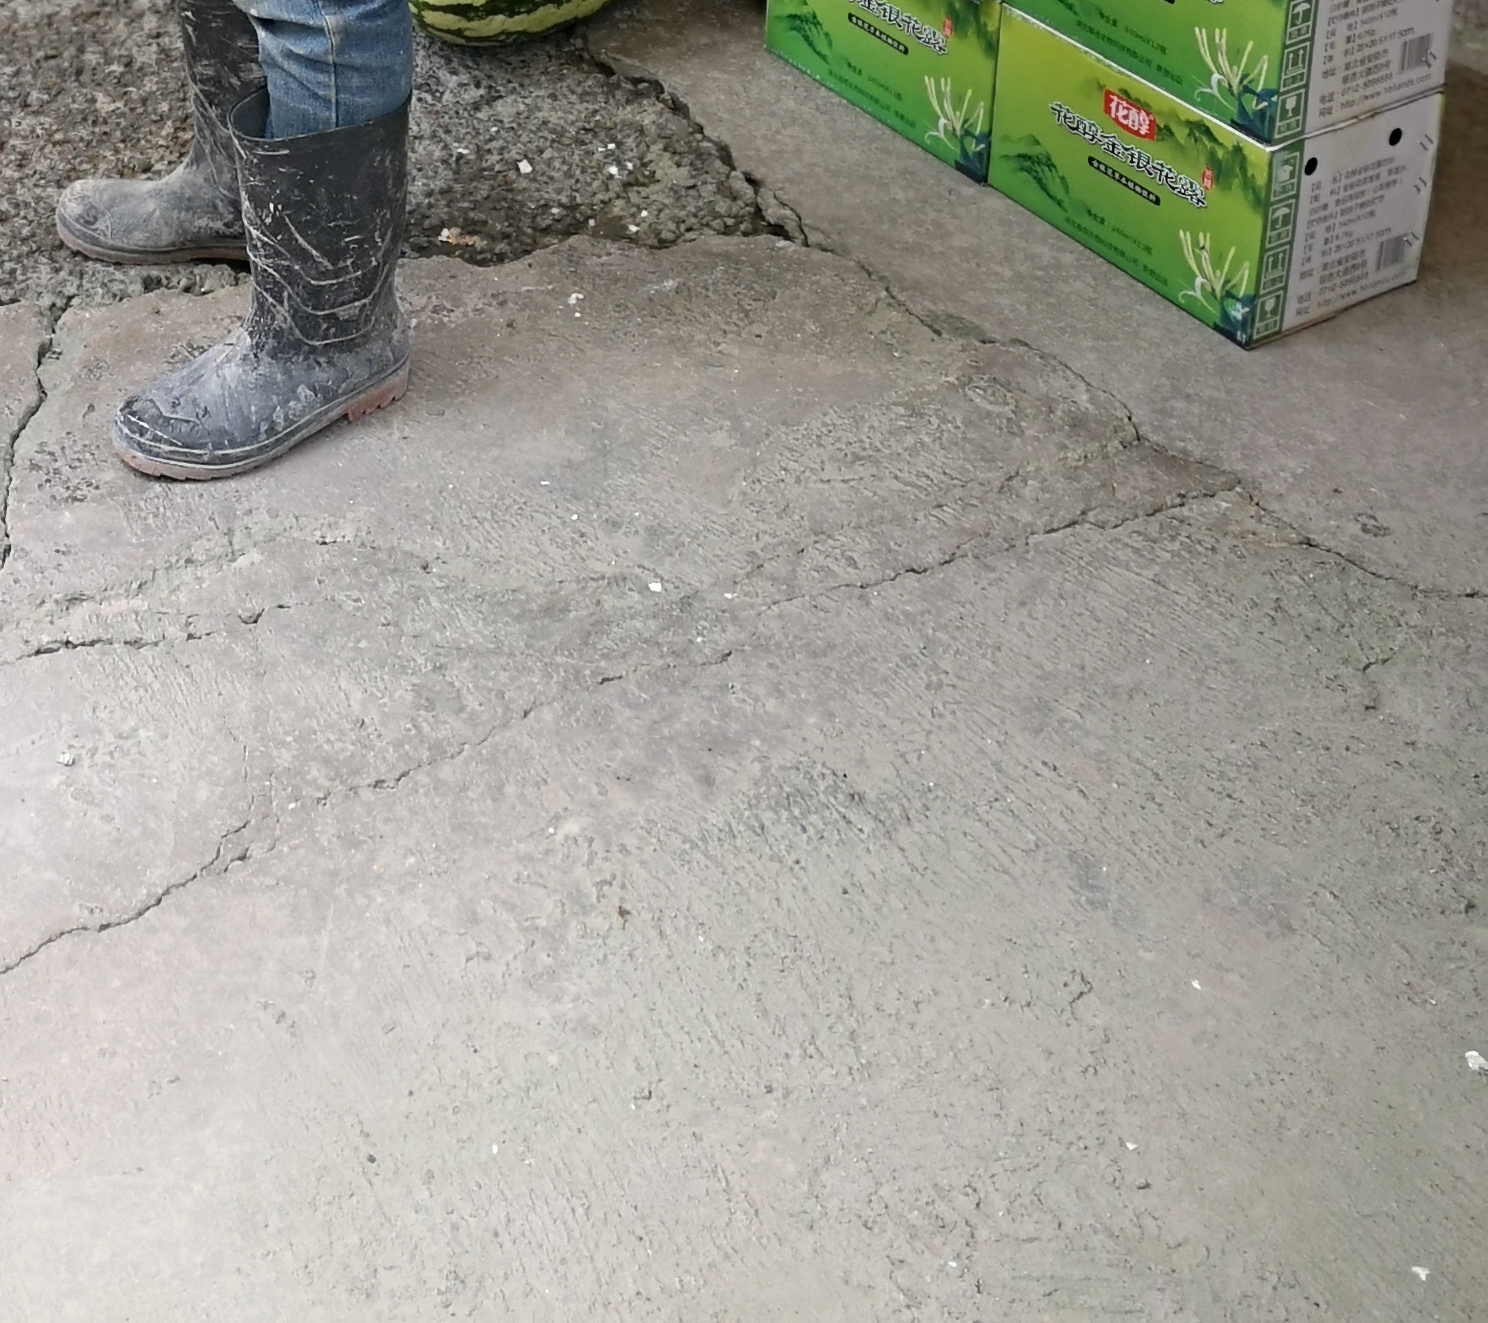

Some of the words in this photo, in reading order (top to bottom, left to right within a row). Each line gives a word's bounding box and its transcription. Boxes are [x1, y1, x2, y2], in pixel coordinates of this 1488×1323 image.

[1048, 100, 1207, 209] 花醇金银花露
[1108, 95, 1150, 138] 花醇
